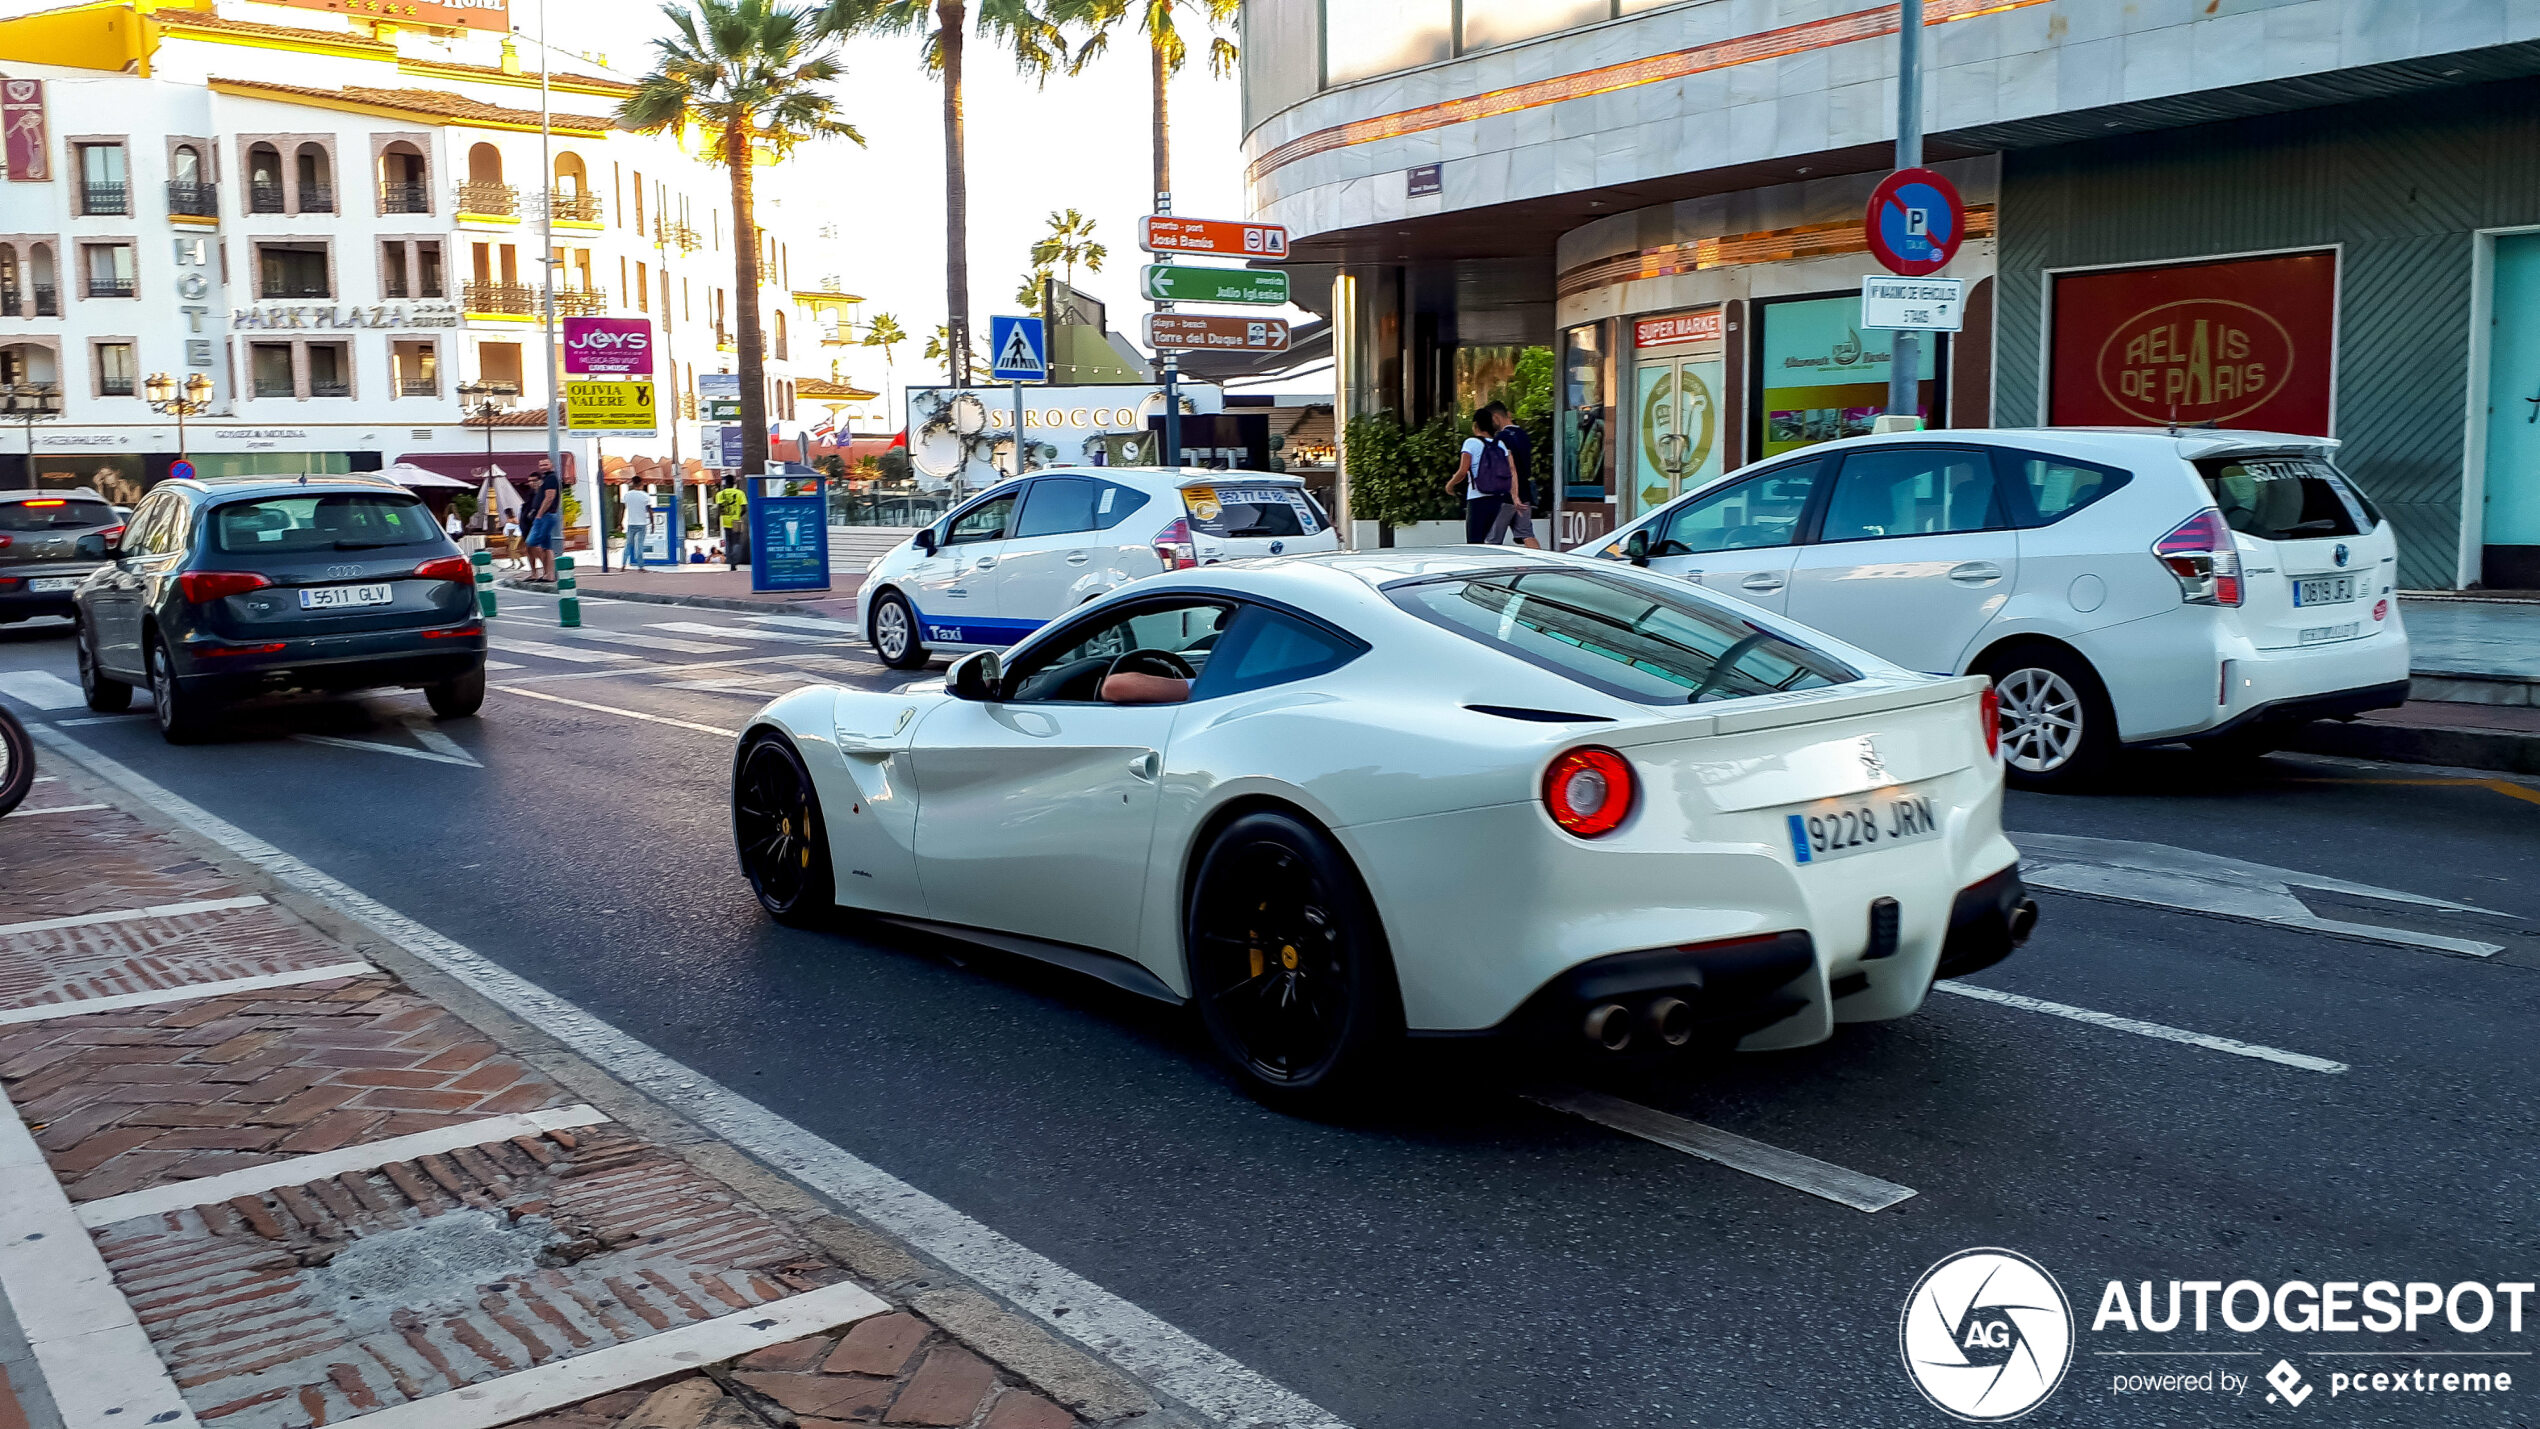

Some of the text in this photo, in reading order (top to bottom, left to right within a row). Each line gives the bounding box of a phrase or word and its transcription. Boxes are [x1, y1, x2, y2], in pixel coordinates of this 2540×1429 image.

[1185, 223, 1204, 233] port
[1910, 210, 1923, 233] P
[1152, 233, 1214, 248] José Banús
[173, 238, 213, 367] HOTE
[1216, 286, 1285, 300] Julio Iglesias
[234, 305, 408, 329] PARK PLAZA
[1637, 314, 1721, 340] SUPER MARKET
[1152, 331, 1244, 347] Torre del Duque
[2126, 319, 2250, 370] RELAIS
[2121, 347, 2265, 406] DE PARIS
[571, 385, 622, 396] OLIVIA
[570, 396, 627, 407] VALERE
[991, 408, 1134, 429] SIROCCO
[314, 587, 385, 604] 5511 GLV
[929, 625, 963, 642] Taxi
[1808, 796, 1937, 853] 9228 JRN
